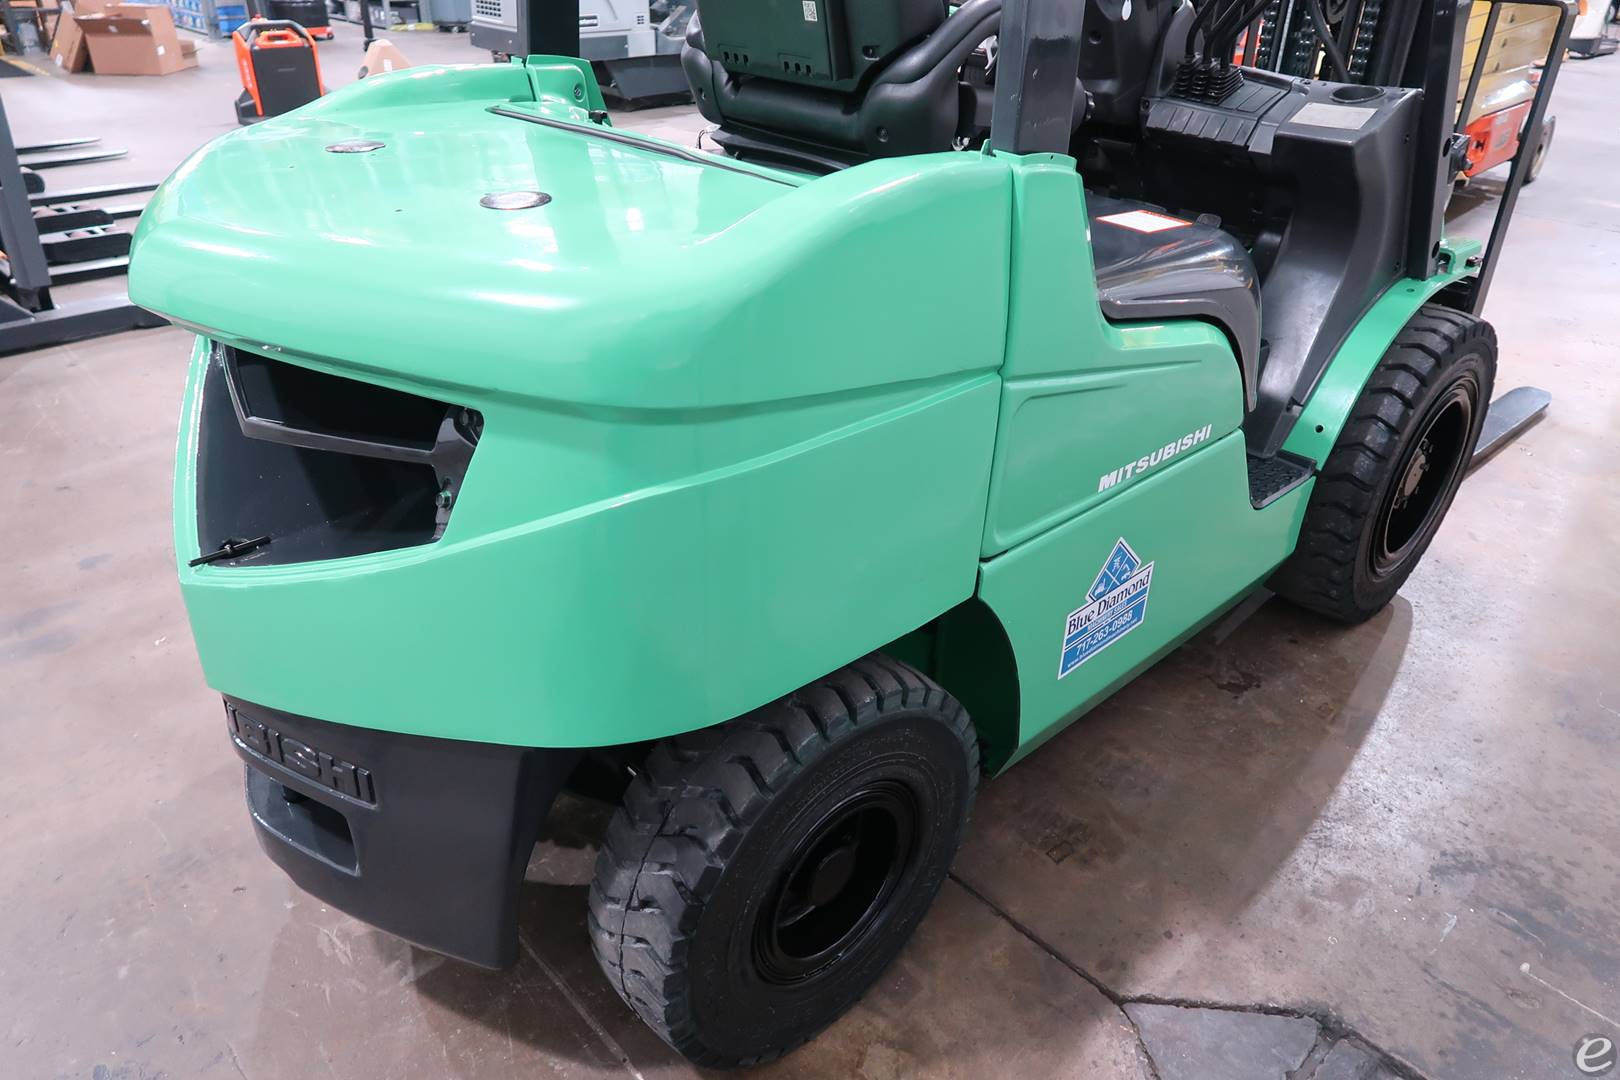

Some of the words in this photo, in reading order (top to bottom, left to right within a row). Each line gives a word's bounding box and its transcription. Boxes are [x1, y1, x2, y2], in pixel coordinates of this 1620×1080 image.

[1098, 423, 1212, 493] MITSUBISHI
[1068, 610, 1094, 635] Blue
[1097, 570, 1150, 616] Diamond
[1076, 609, 1133, 656] 717-263-0988
